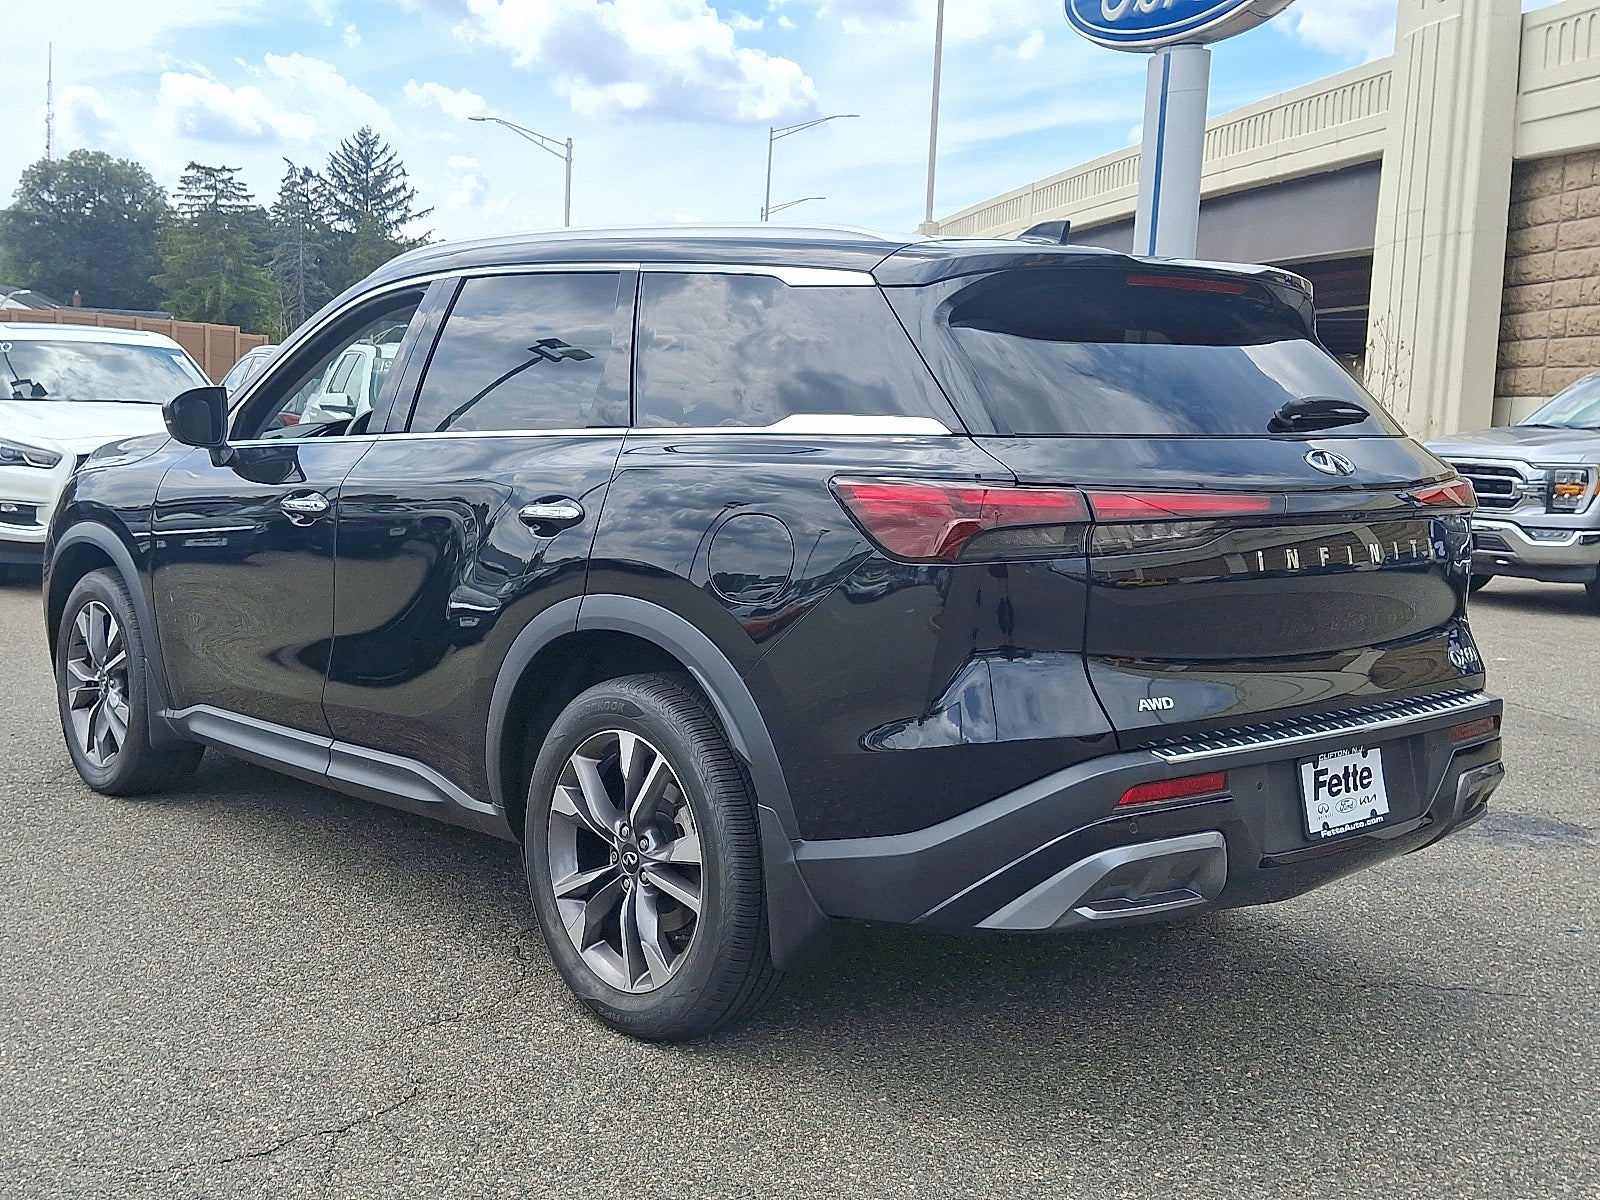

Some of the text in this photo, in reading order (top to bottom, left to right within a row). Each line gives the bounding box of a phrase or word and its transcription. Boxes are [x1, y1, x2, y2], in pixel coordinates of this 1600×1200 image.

[1138, 696, 1175, 712] AWD
[1313, 763, 1373, 802] Fette
[1320, 816, 1384, 838] FetteAuto.com
